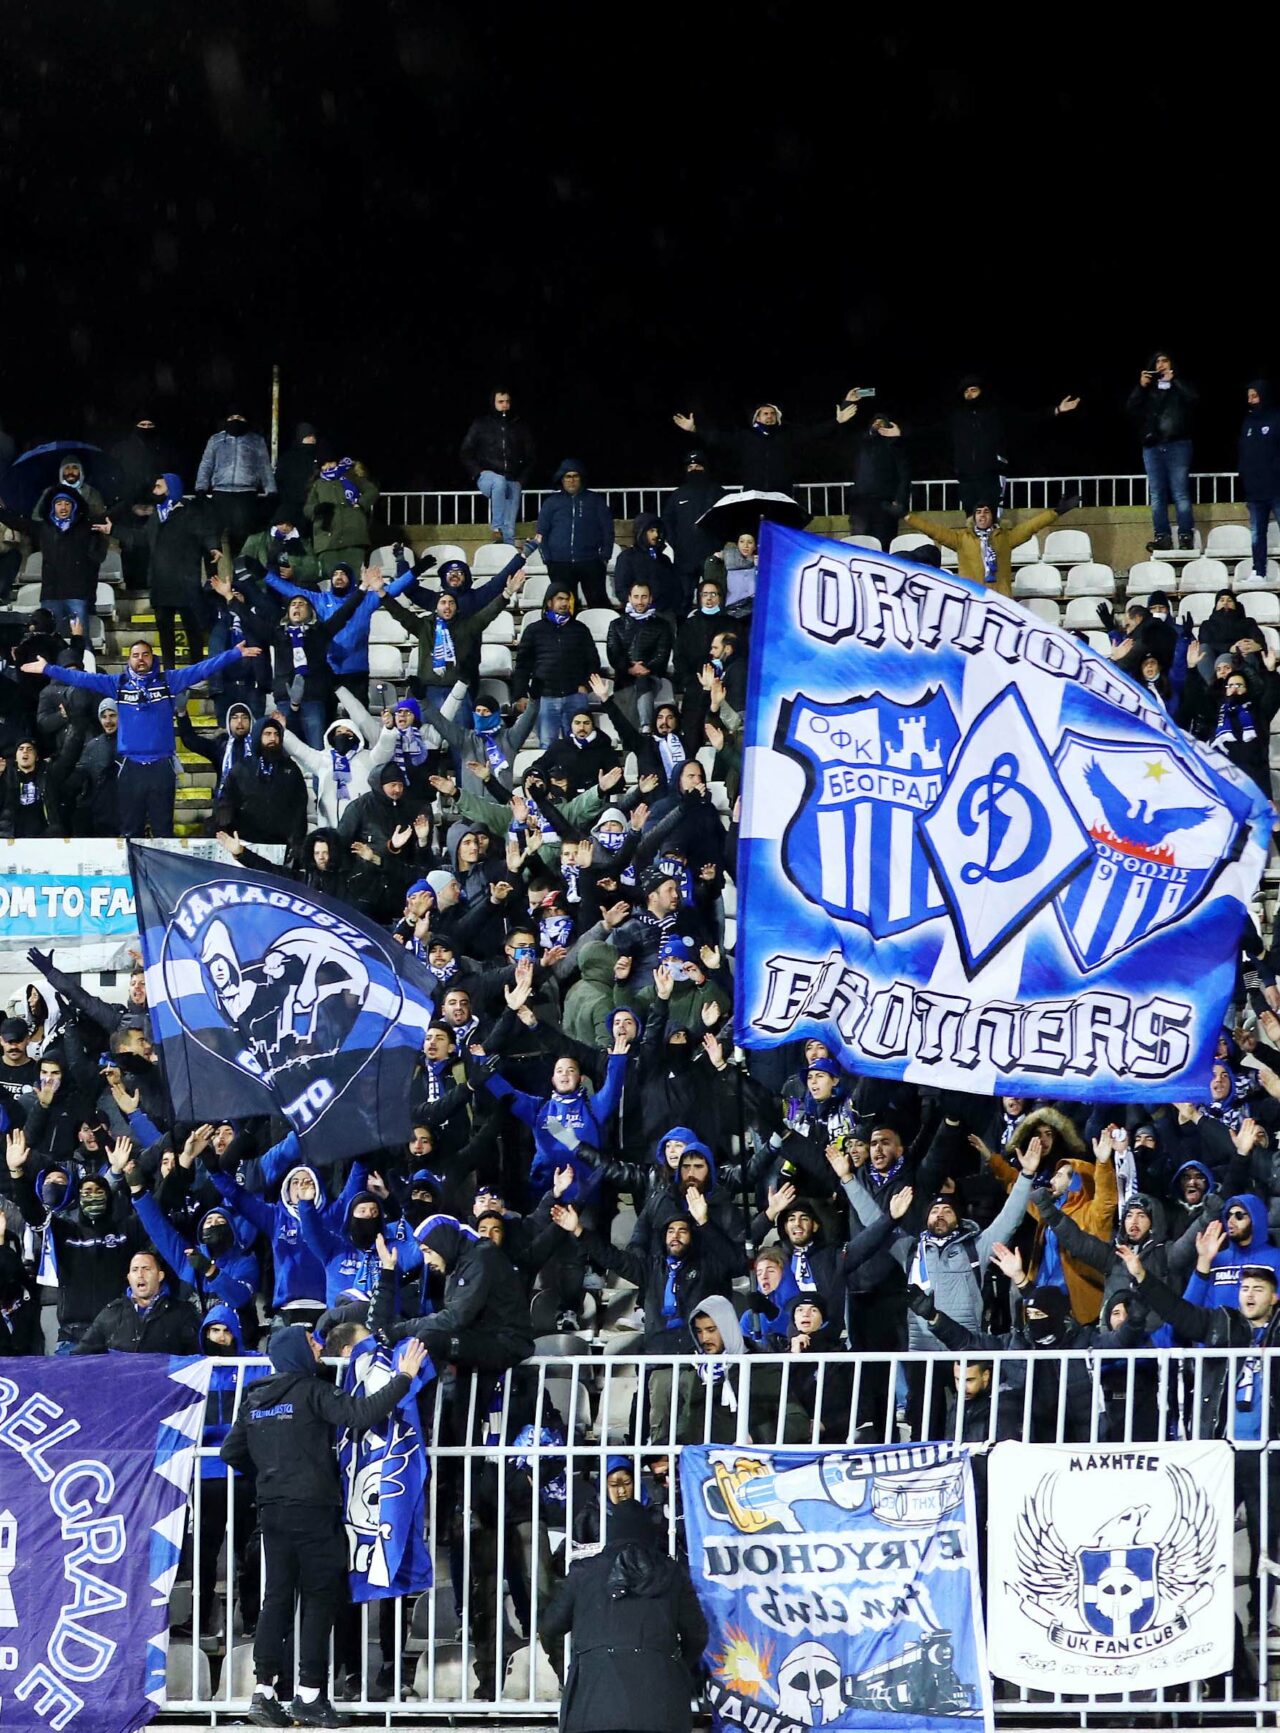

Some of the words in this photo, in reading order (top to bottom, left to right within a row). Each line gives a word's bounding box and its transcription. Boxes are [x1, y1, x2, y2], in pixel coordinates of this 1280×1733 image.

[828, 770, 941, 807] БЕОГРАД
[1094, 842, 1192, 885] ΟΡΘΩΣΙΣ
[41, 886, 85, 918] TO
[176, 884, 373, 949] FAMAGUSTA
[752, 950, 1191, 1079] BROTHERS
[1067, 1633, 1090, 1650] UK
[1094, 1638, 1130, 1654] FAN
[1134, 1626, 1174, 1650] CLUB
